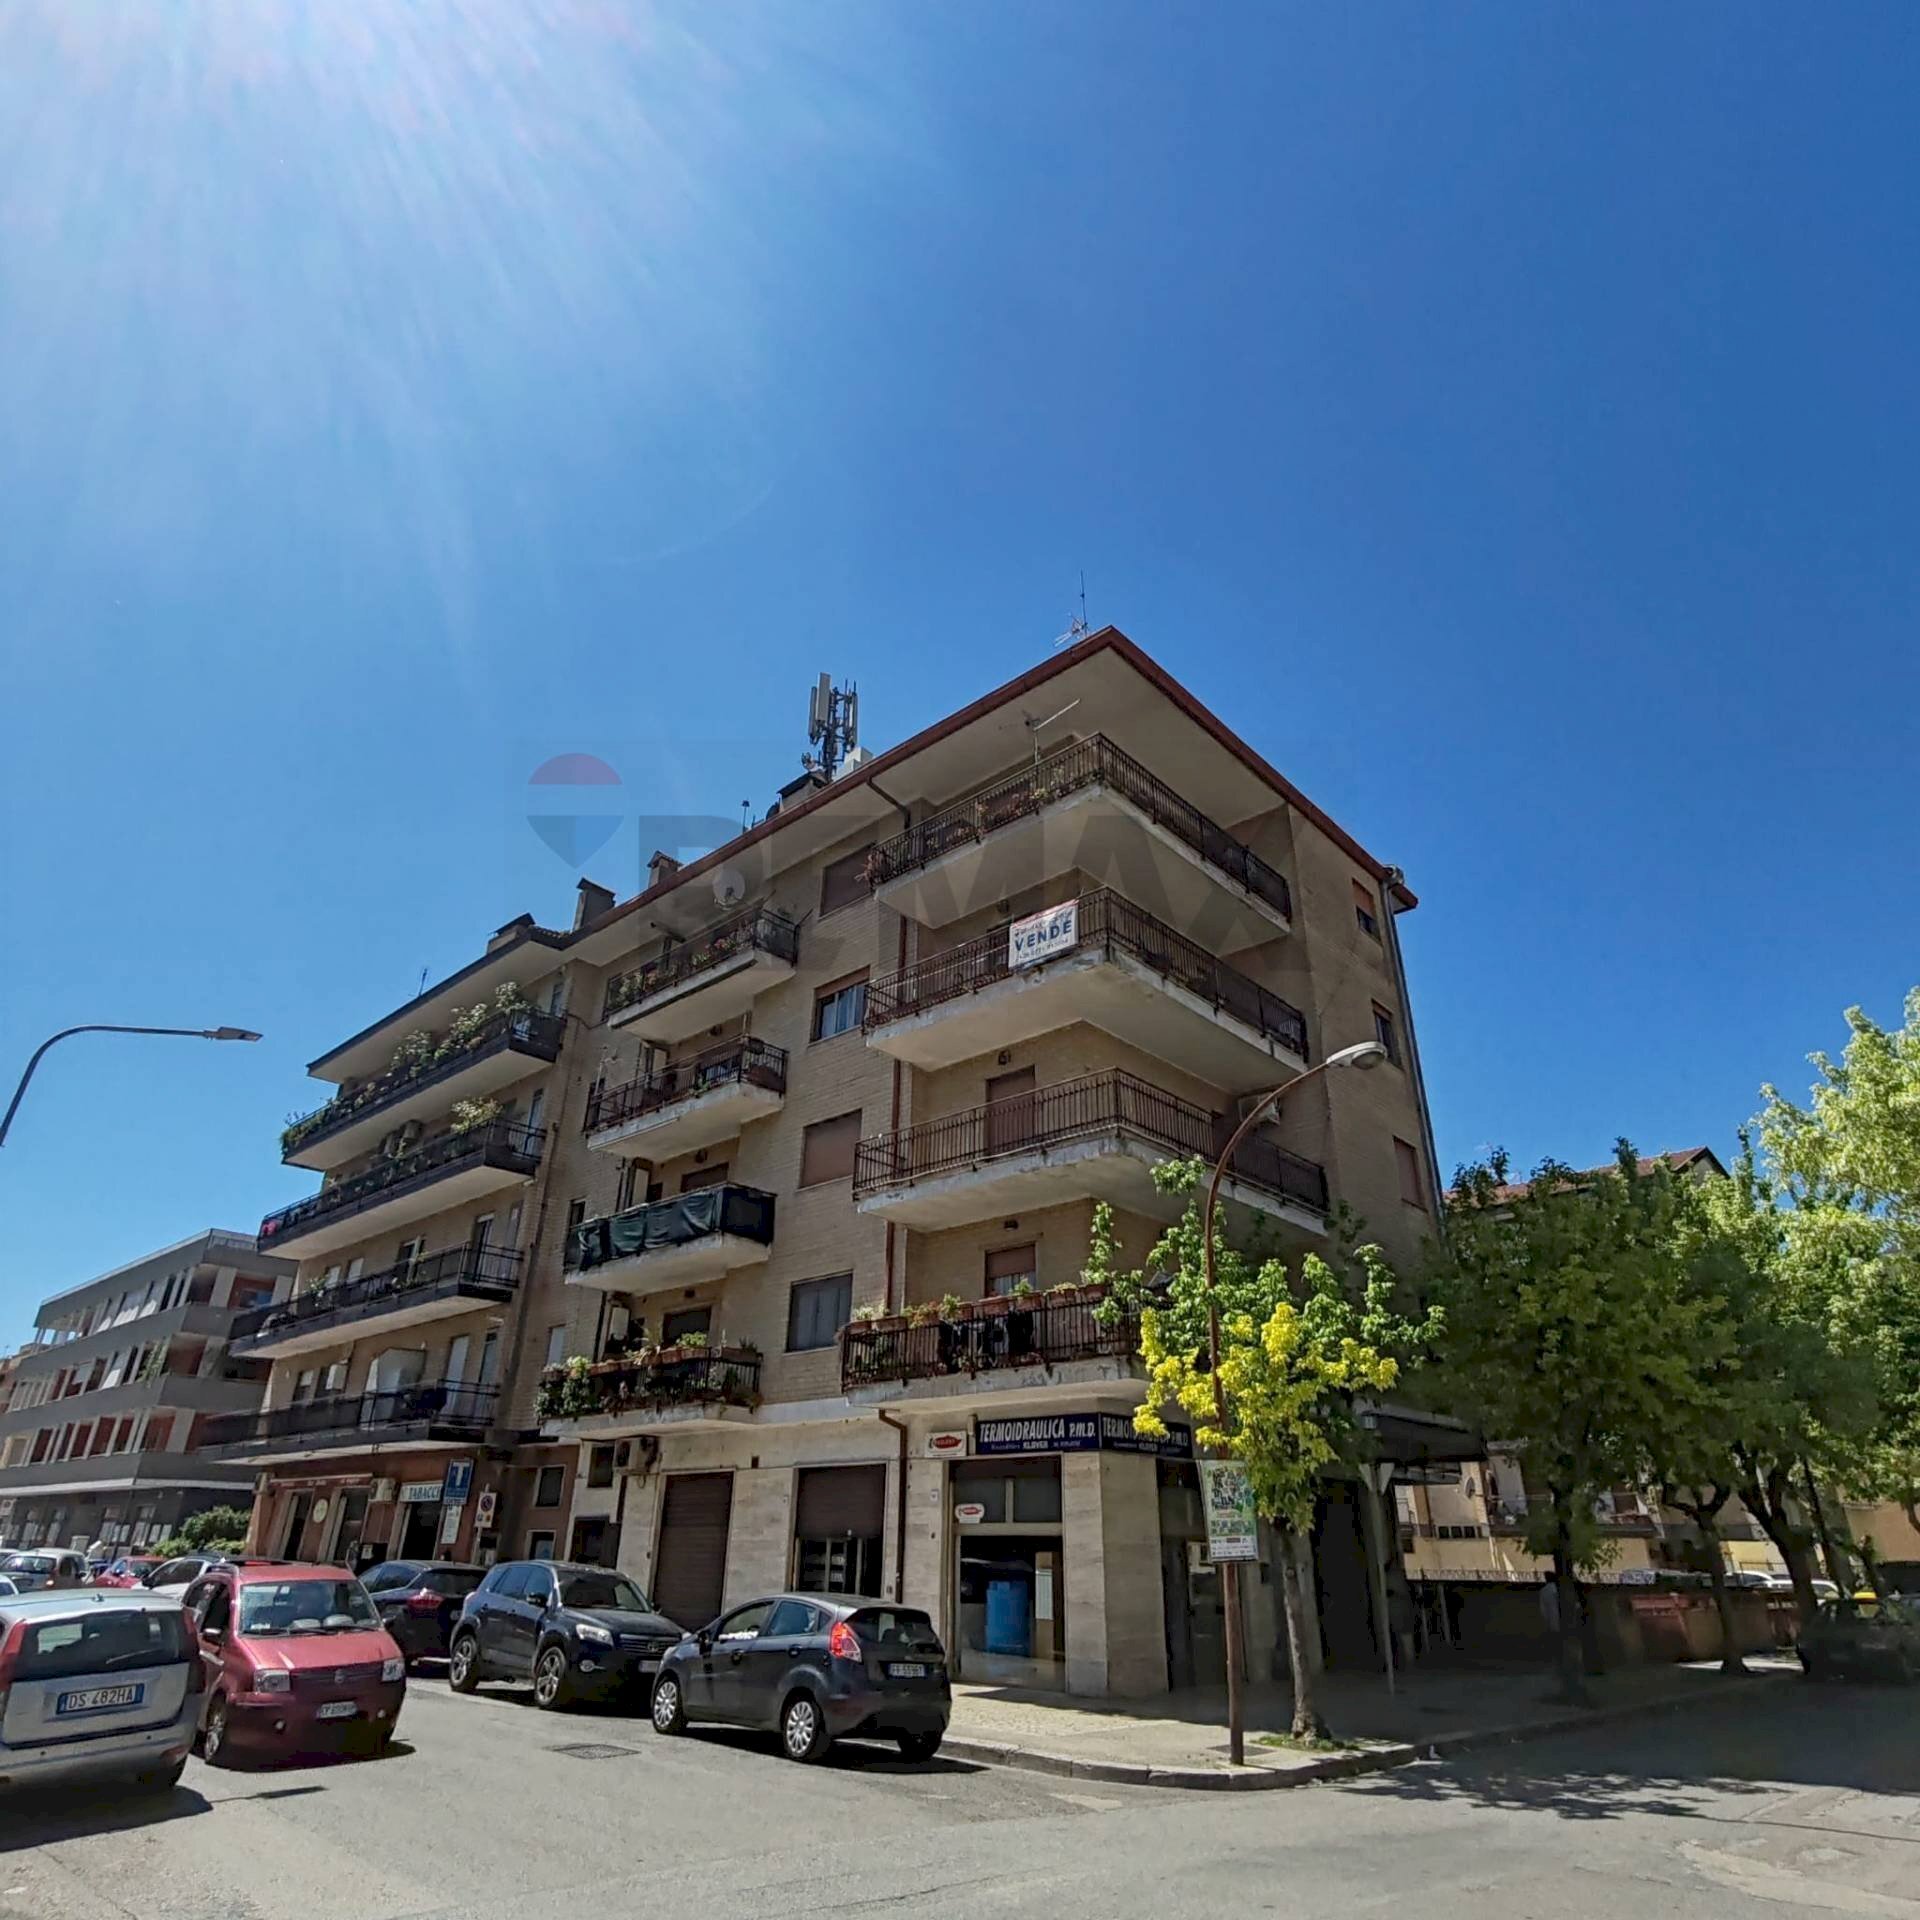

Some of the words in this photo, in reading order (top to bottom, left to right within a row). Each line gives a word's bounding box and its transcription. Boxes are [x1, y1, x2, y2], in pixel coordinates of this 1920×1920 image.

[1015, 920, 1072, 951] VENDE
[980, 1418, 1065, 1443] TERMOIDRAULICA
[68, 1693, 87, 1709] DS
